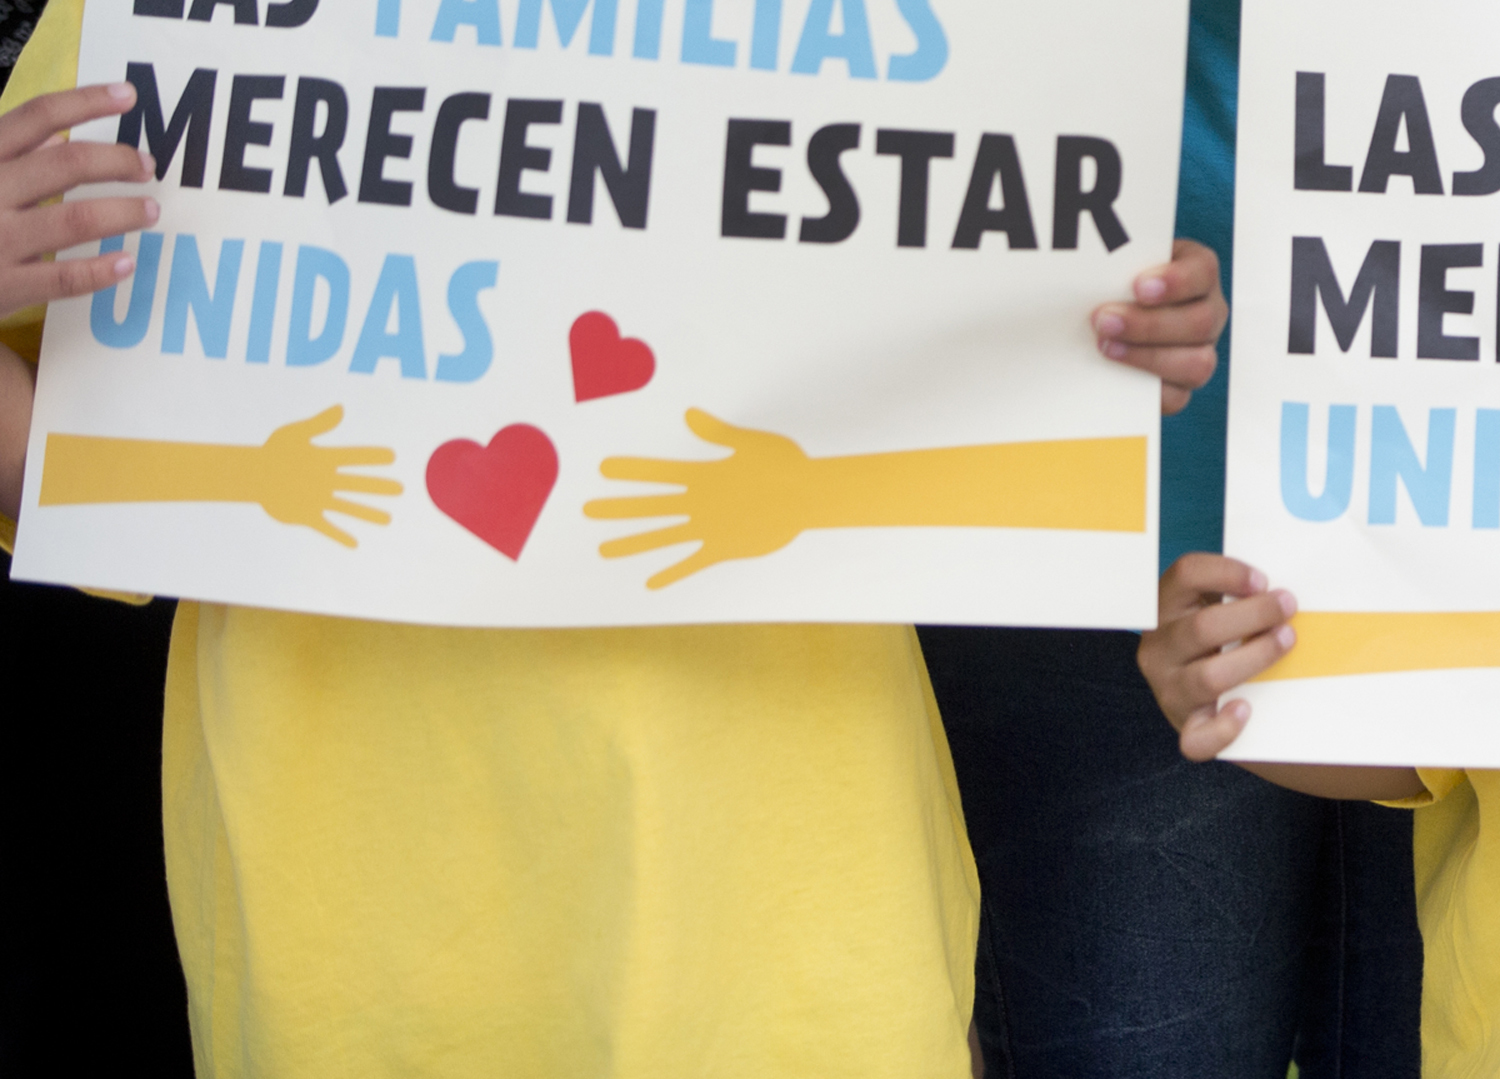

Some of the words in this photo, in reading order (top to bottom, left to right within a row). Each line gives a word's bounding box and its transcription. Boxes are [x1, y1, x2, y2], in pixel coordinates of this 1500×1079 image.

[116, 61, 659, 231] MERECEN
[718, 117, 1131, 255] ESTAR
[90, 231, 501, 384] UNIDAS
